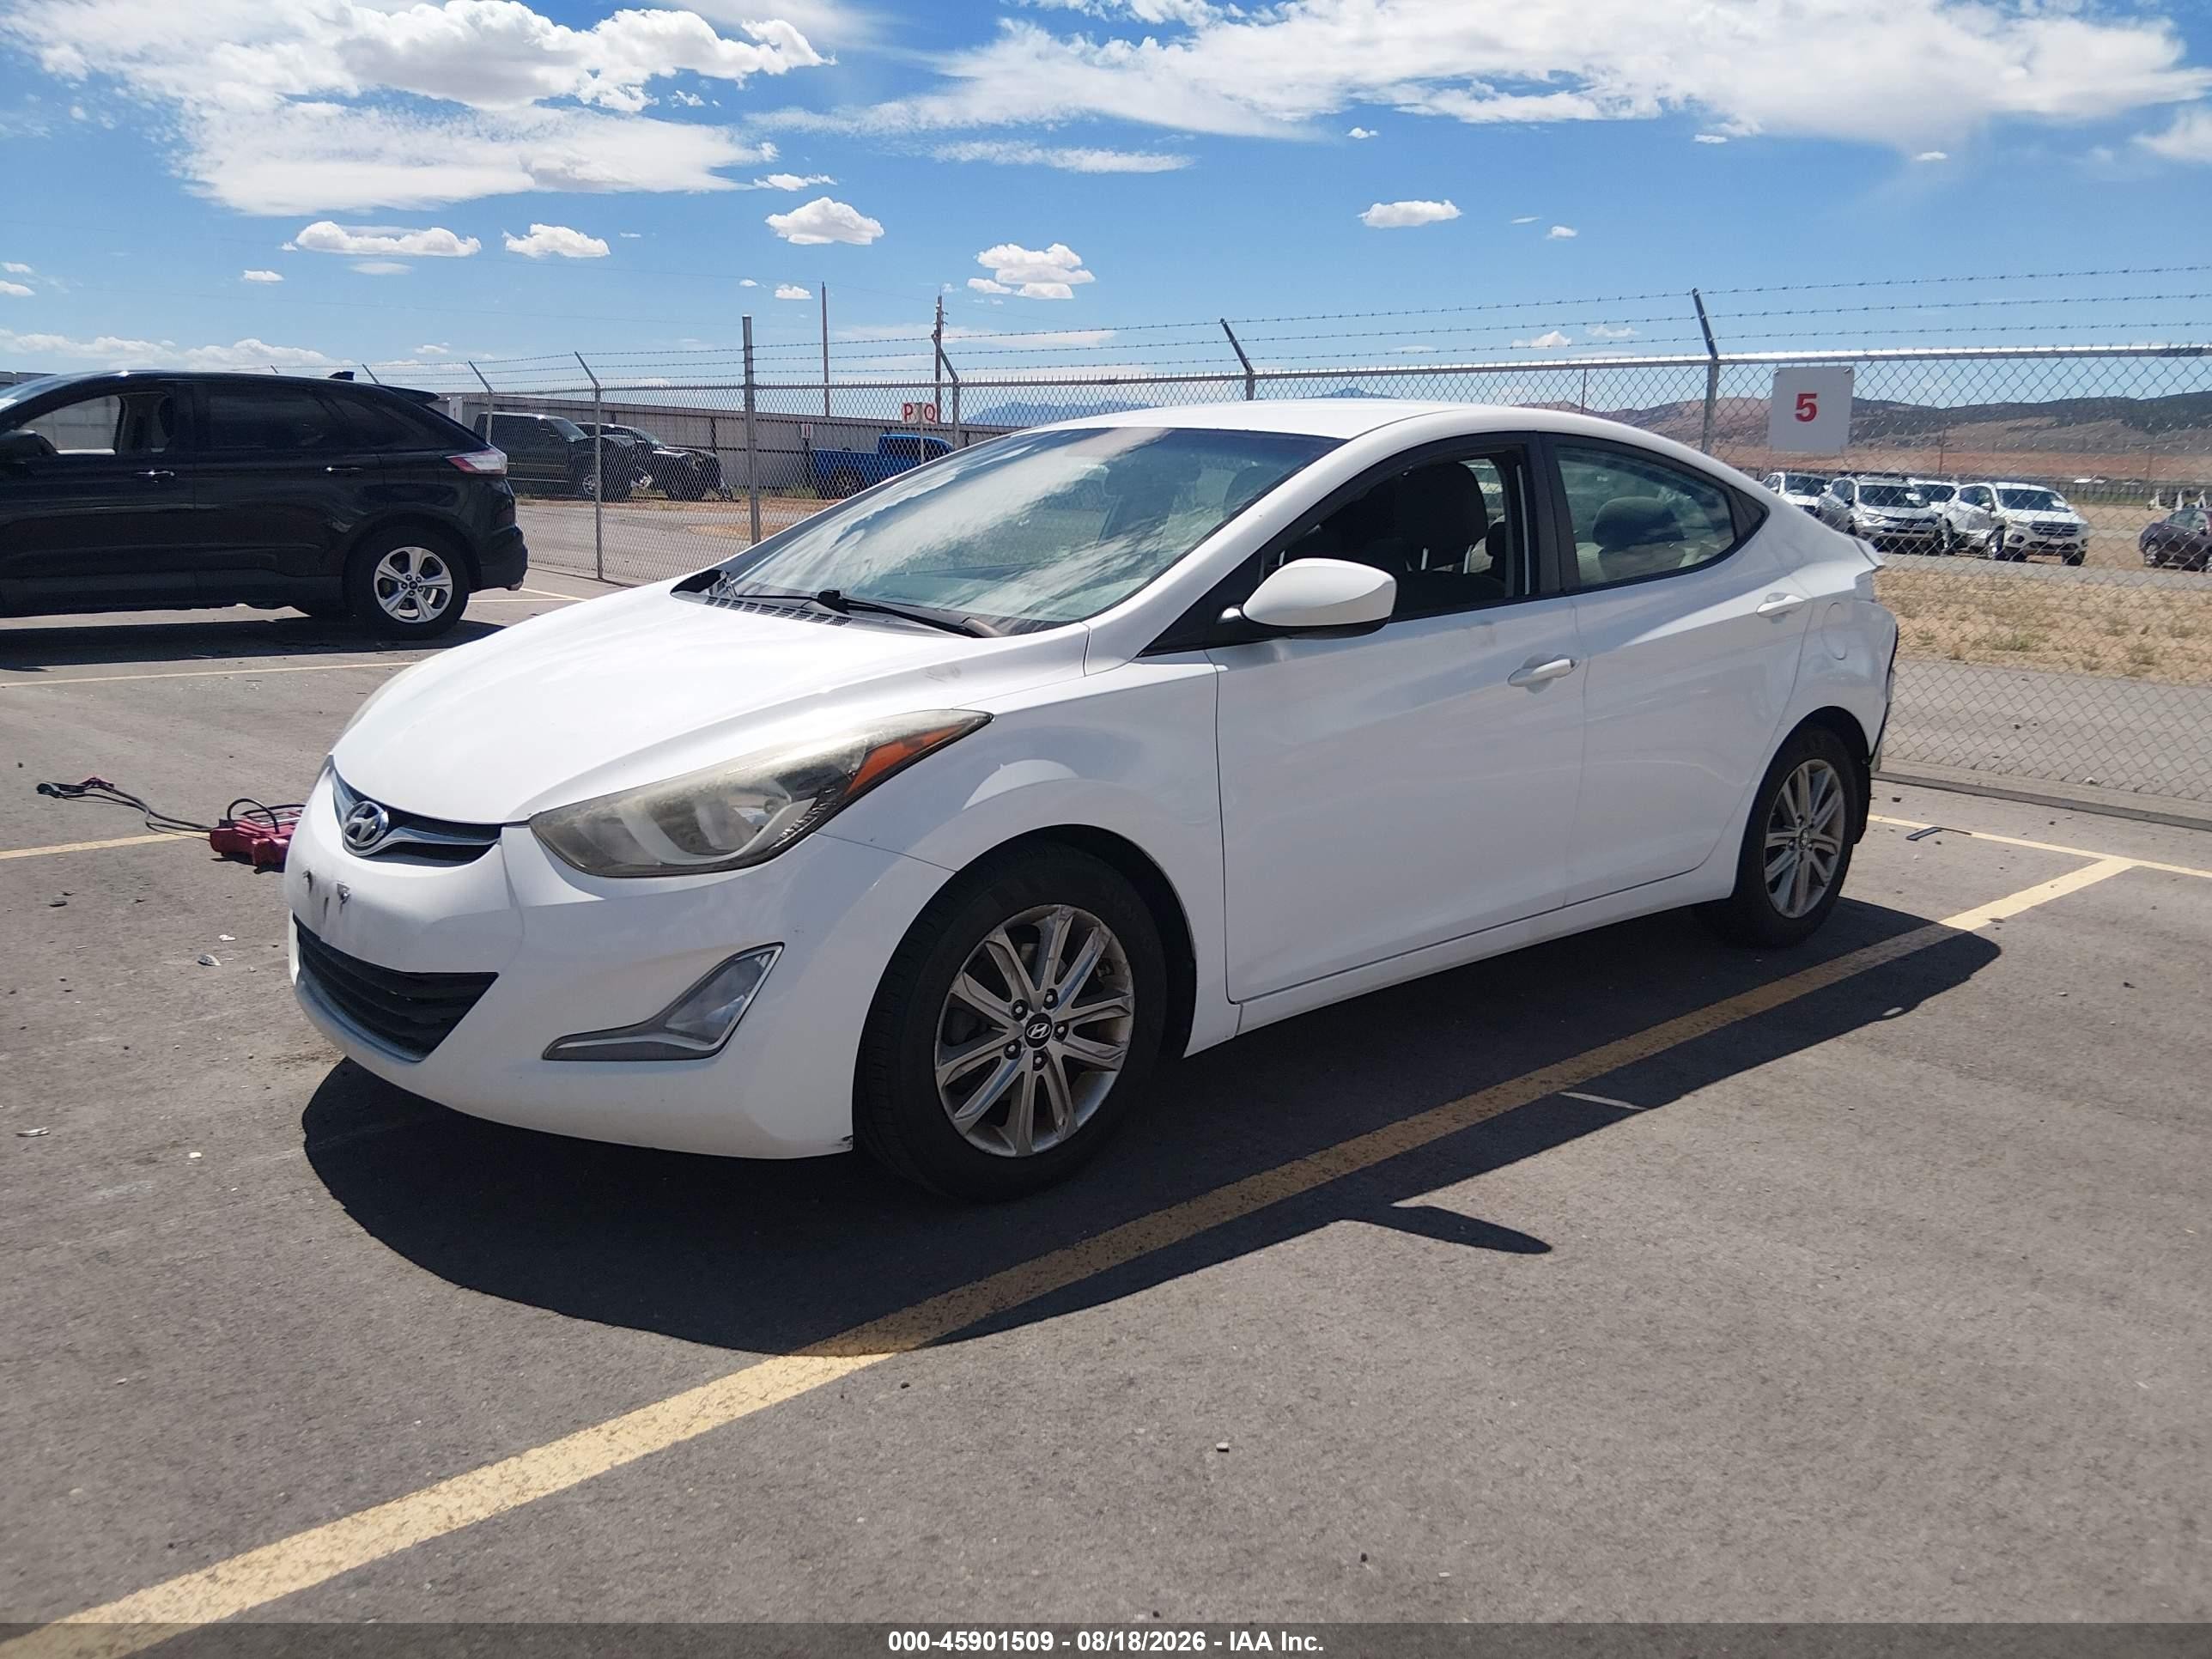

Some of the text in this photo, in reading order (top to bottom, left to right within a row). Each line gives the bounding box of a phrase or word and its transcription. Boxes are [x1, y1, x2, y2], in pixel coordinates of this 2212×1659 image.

[904, 404, 913, 422] P
[924, 404, 936, 422] Q
[1795, 393, 1817, 422] 5
